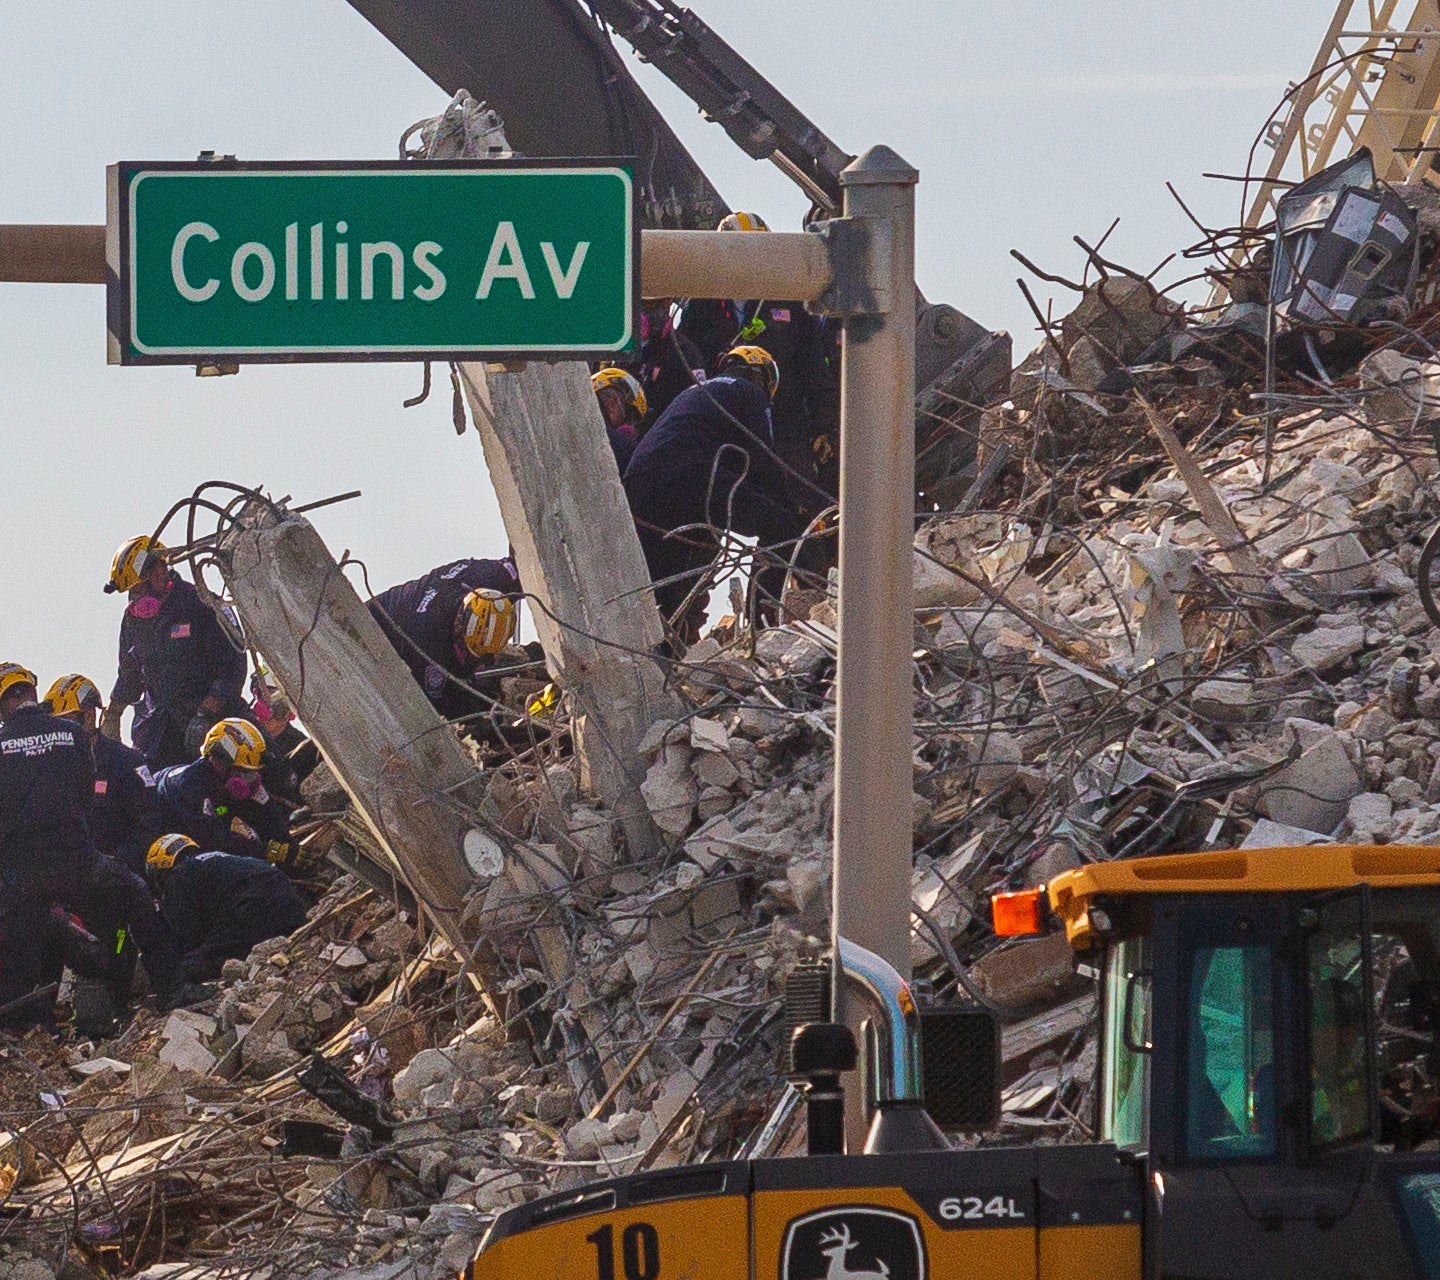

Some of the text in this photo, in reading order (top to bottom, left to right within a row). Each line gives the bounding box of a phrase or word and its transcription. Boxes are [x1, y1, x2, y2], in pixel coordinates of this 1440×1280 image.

[171, 220, 591, 302] Collins Av
[0, 731, 75, 750] PENNSYLVANIA
[939, 1196, 1025, 1220] 624L
